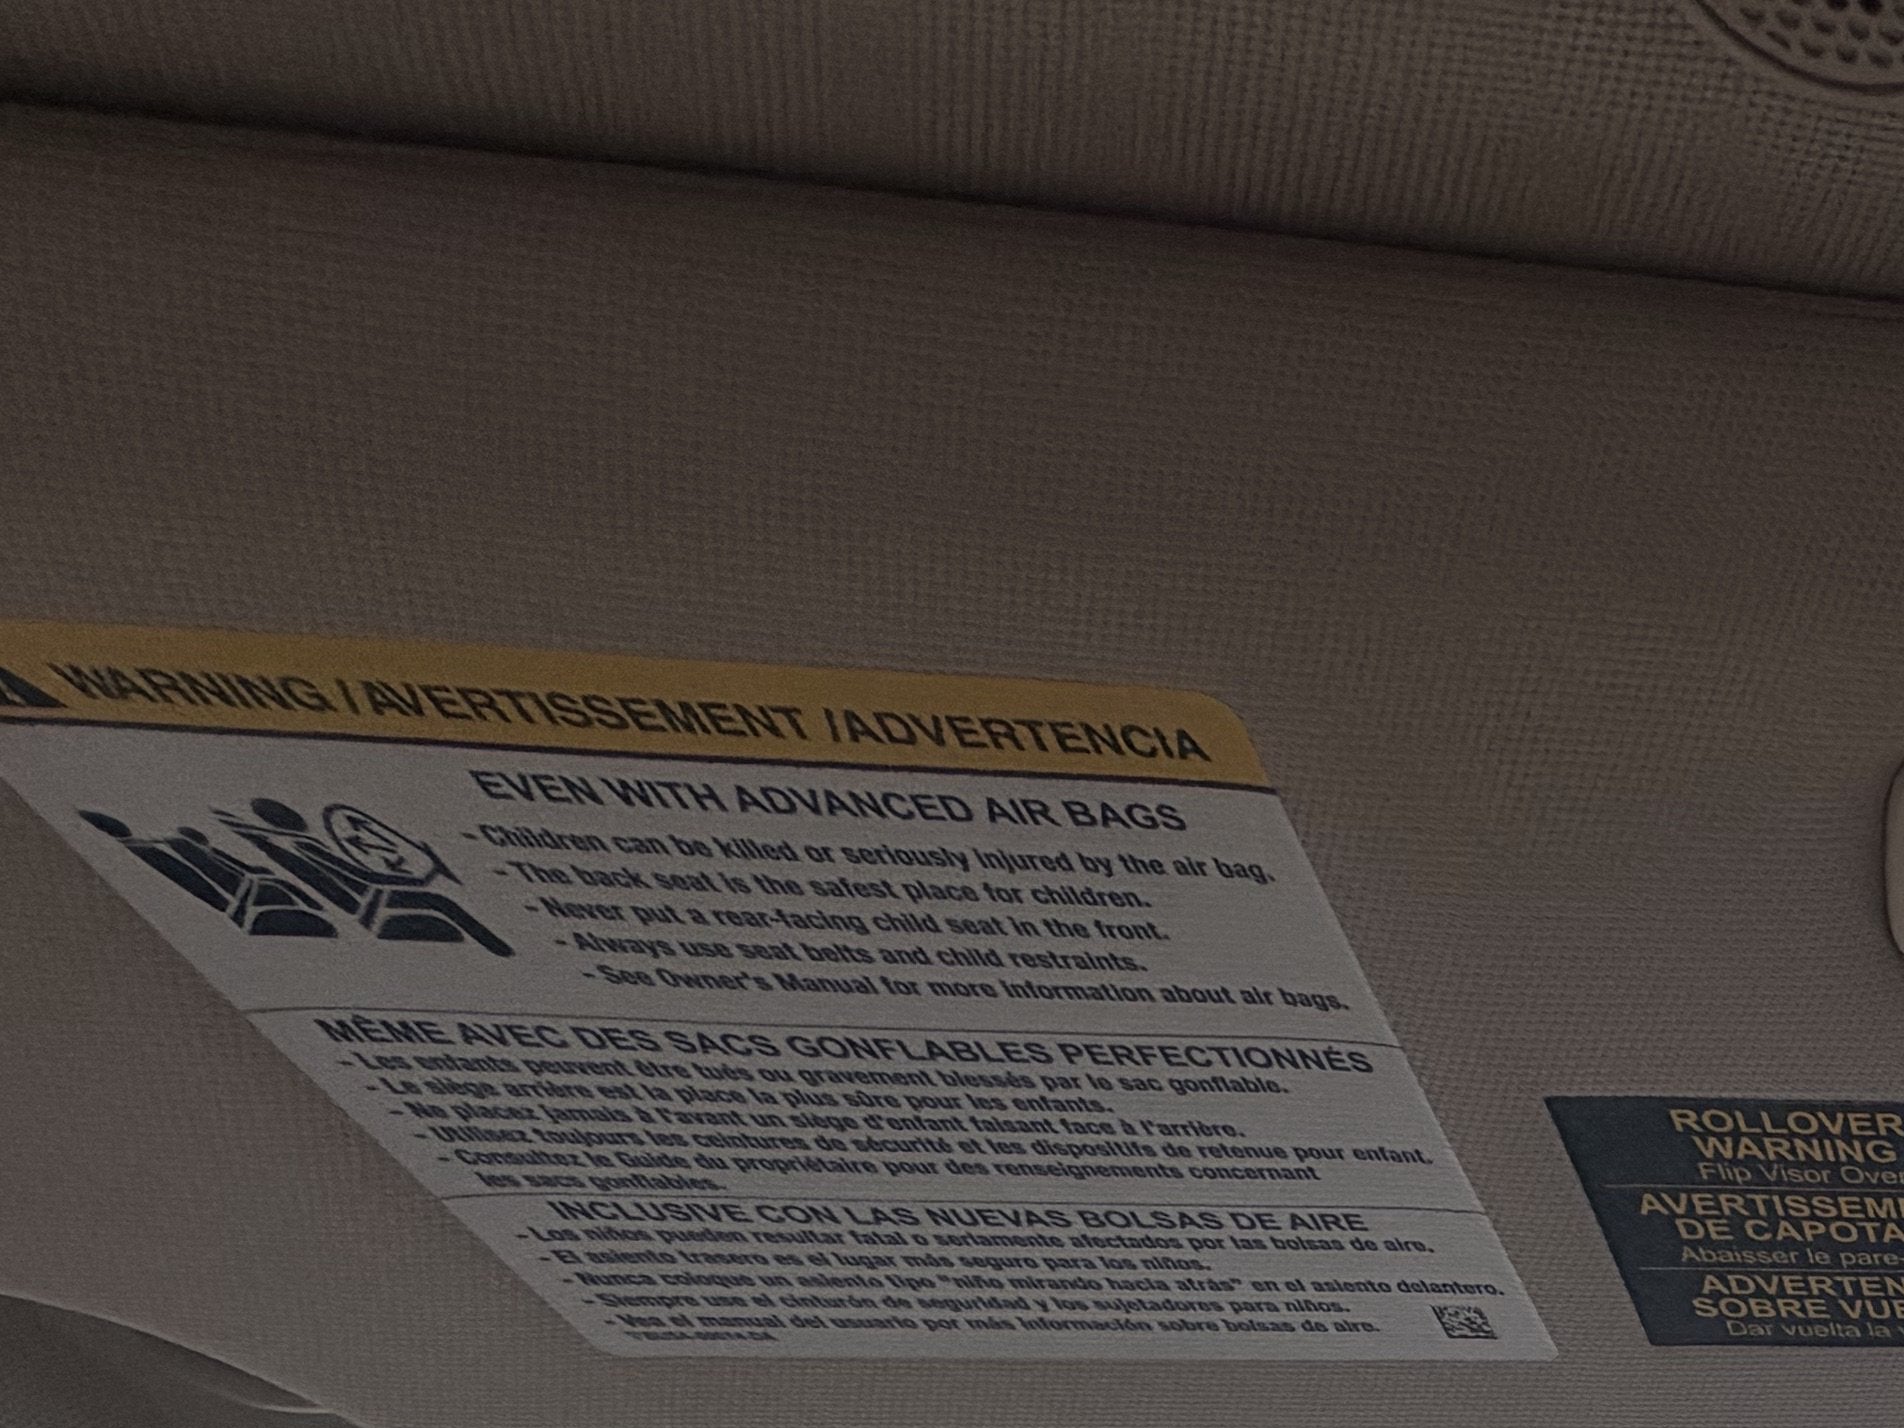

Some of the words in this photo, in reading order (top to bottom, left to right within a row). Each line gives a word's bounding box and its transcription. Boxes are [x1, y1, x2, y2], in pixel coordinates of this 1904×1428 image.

[46, 662, 338, 713] WARNING
[469, 769, 605, 806] EVEN
[600, 776, 729, 812] WITH
[734, 783, 975, 823] ADVANCED
[986, 797, 1062, 827] AIR
[1061, 800, 1188, 832] BAGS
[477, 823, 609, 853] Children
[610, 835, 669, 858] can
[668, 833, 713, 859] be
[711, 835, 800, 864] killed
[804, 842, 836, 862] or
[841, 844, 969, 872] seriously
[975, 847, 1073, 875] injured
[1078, 851, 1115, 879] by
[1118, 853, 1165, 877] the
[1171, 856, 1208, 878] air
[1212, 857, 1277, 886] bag.
[313, 1014, 454, 1045] MÊME
[457, 1021, 570, 1049] AVEC
[569, 1026, 663, 1053] DES
[663, 1029, 782, 1057] SACS
[785, 1036, 1055, 1064] GONFLABLES
[1055, 1042, 1375, 1074] PERFECTIONNÉS
[1692, 1136, 1897, 1164] WARNING
[1699, 1163, 1753, 1185] Flip
[1761, 1163, 1832, 1184] Visor
[547, 1200, 752, 1223] INCLUSIVE
[754, 1204, 842, 1225] CON
[842, 1206, 921, 1226] LAS
[922, 1208, 1073, 1229] NUEVAS
[1077, 1210, 1224, 1231] BOLSAS
[1229, 1212, 1282, 1231] DE
[1287, 1213, 1370, 1233] AIRE
[1675, 1218, 1734, 1241] DE
[1680, 1246, 1799, 1266] Abaisser
[1806, 1247, 1830, 1266] le
[1692, 1297, 1828, 1319] SOBRE
[1727, 1320, 1772, 1338] Dar
[1779, 1320, 1859, 1338] vuelta
[1865, 1320, 1891, 1338] la
